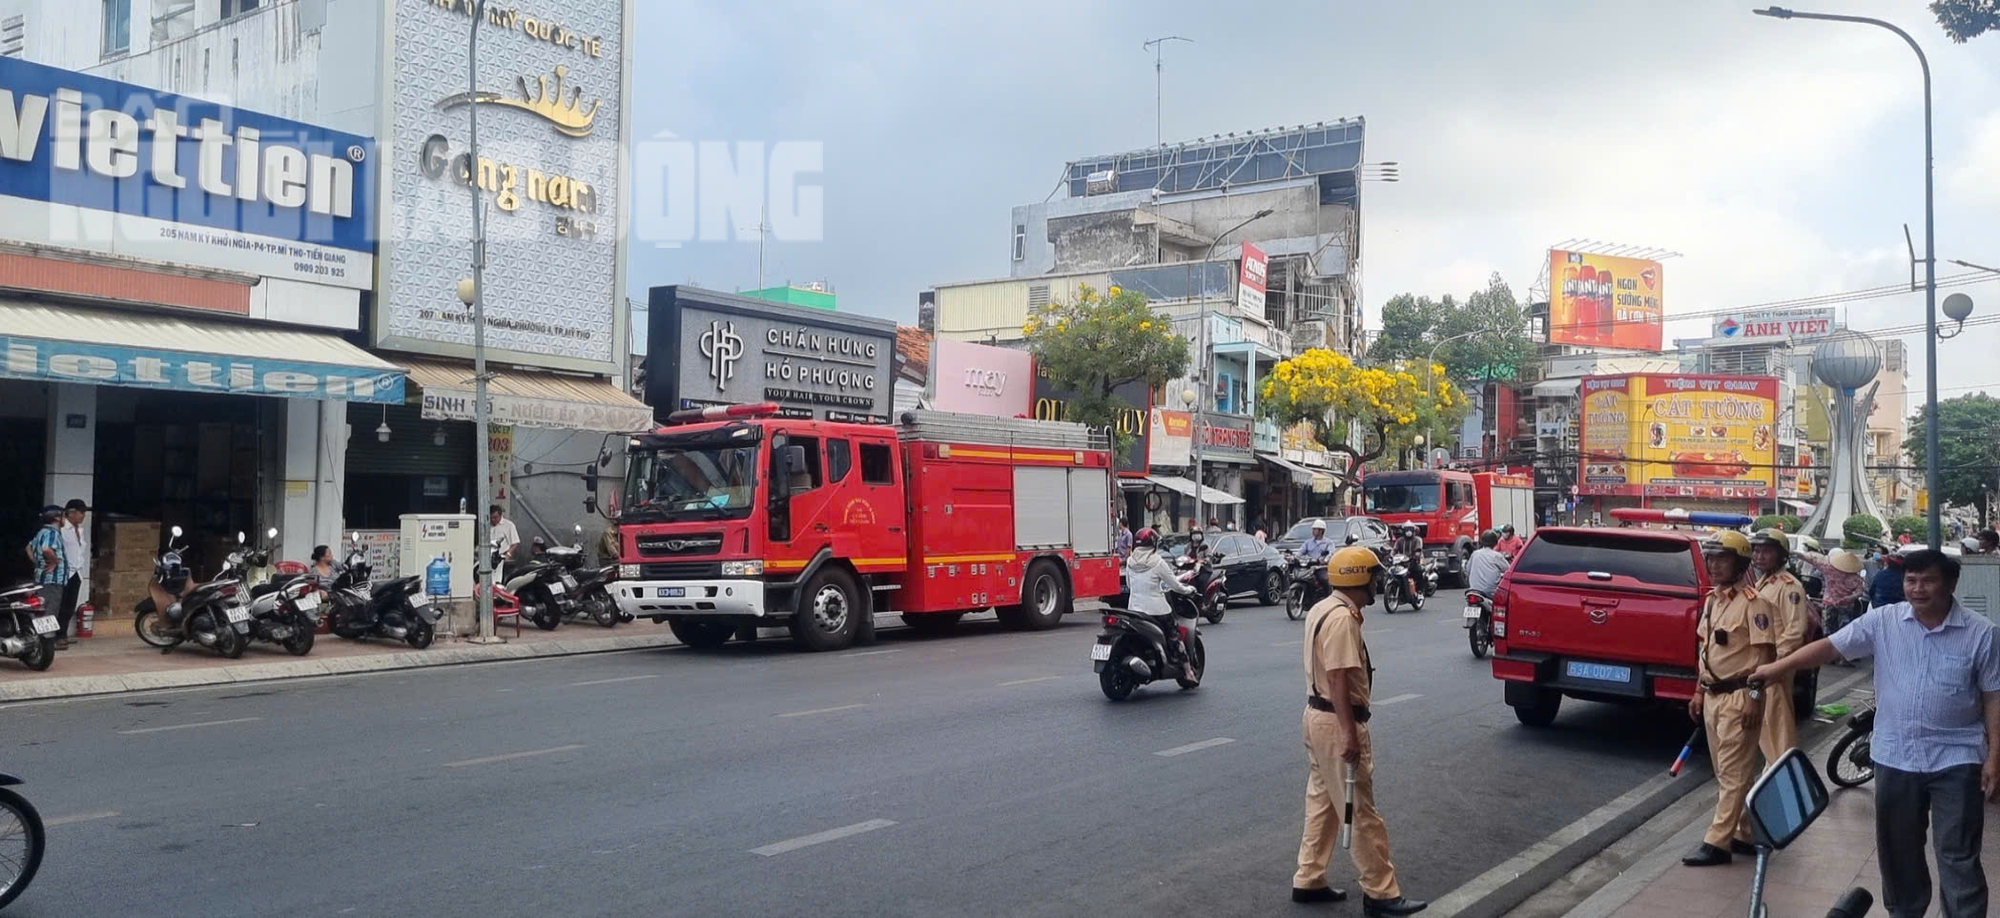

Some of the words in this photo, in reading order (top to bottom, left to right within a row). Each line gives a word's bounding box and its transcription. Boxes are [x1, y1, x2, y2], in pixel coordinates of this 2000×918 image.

[160, 227, 178, 239] 205
[178, 230, 198, 243] NAM
[314, 265, 329, 276] 203
[331, 267, 345, 278] 925
[767, 326, 821, 350] CHẤN
[827, 337, 875, 357] HƯNG
[798, 366, 875, 391] PHƯỢNG
[1724, 380, 1759, 391] QUAY
[767, 388, 791, 398] YOUR
[1653, 394, 1692, 418] CÁT
[1702, 395, 1764, 420] TƯỜNG
[1338, 565, 1367, 575] CSGT
